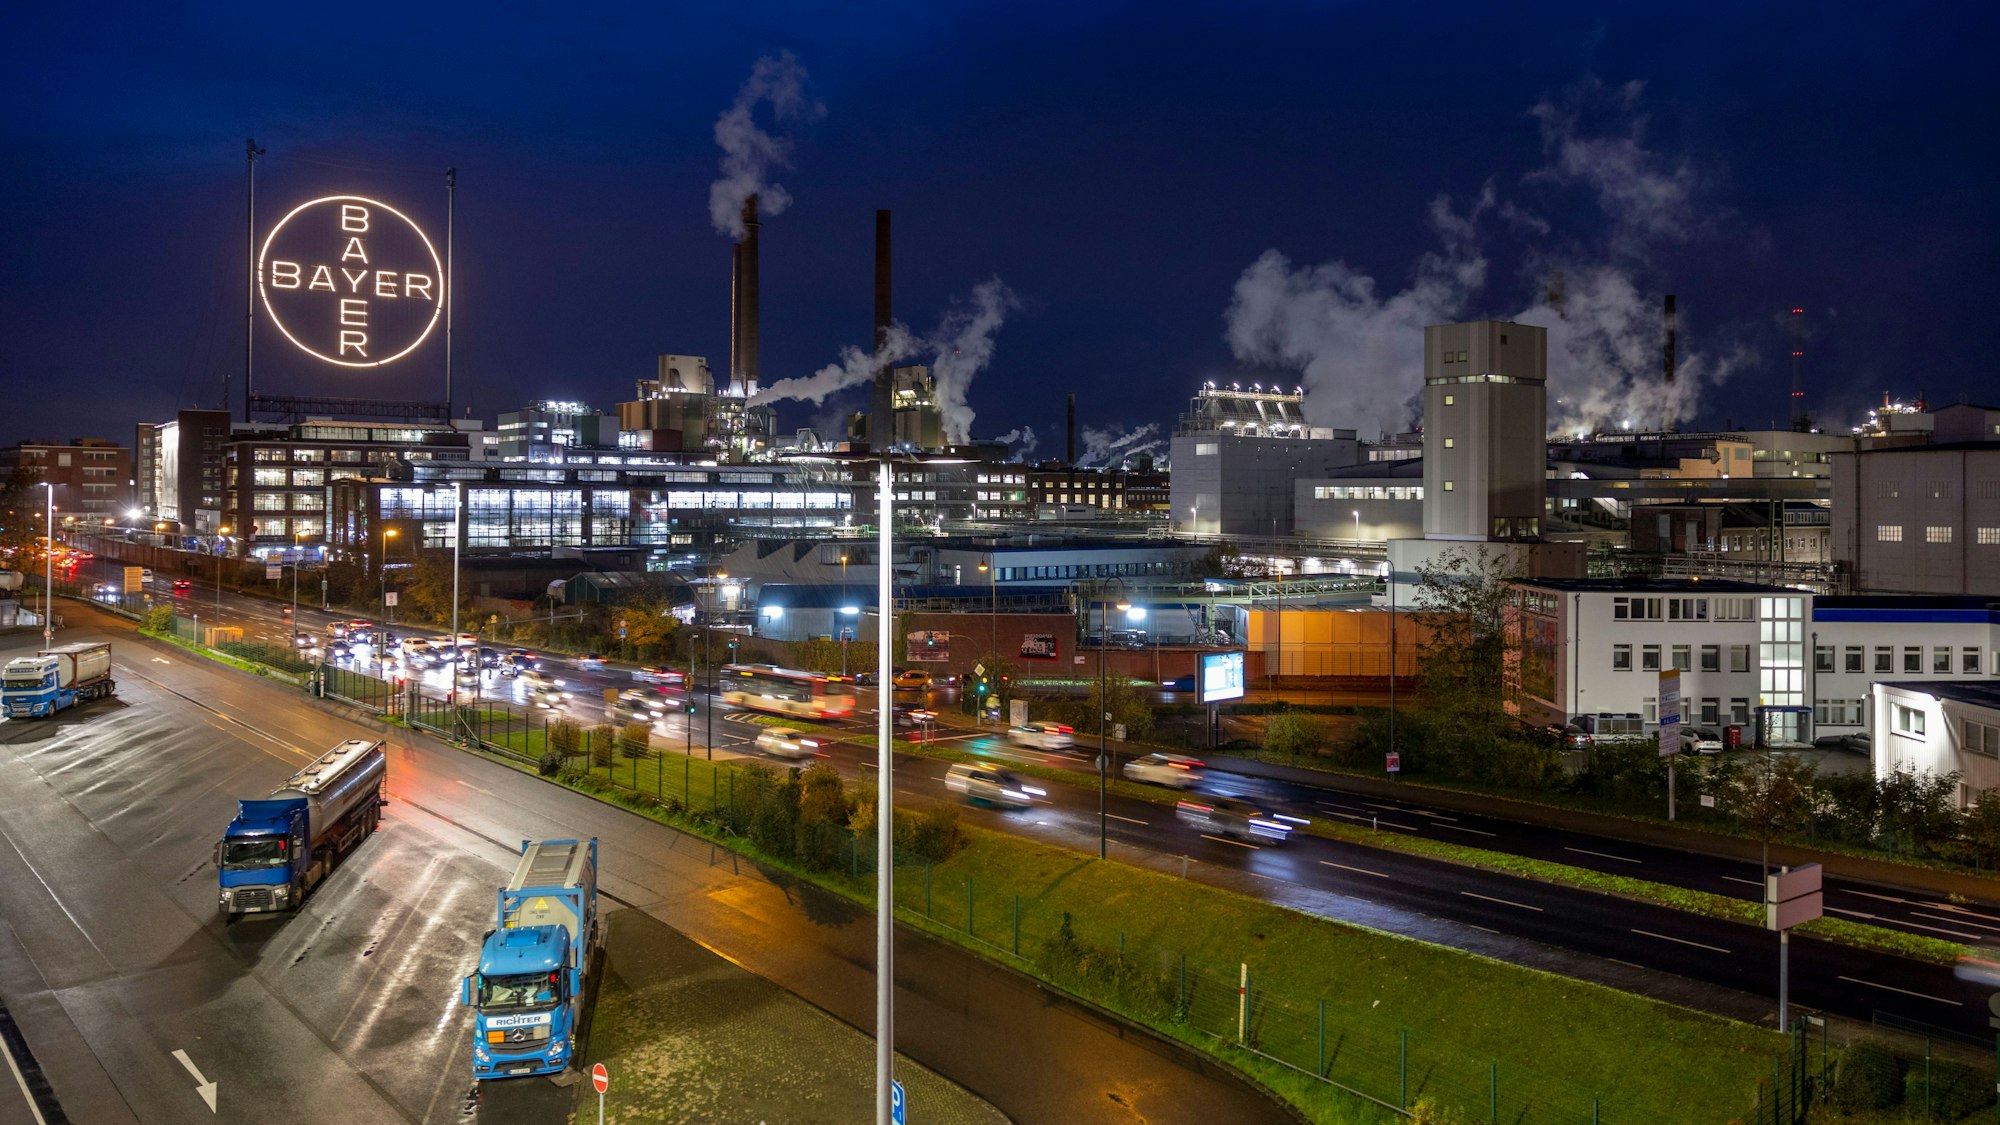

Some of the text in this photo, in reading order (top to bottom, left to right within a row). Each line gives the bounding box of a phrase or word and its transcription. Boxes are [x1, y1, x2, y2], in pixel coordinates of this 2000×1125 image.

[272, 260, 432, 300] BAYER
[340, 204, 369, 357] BAYER
[496, 1015, 541, 1026] RICHTER
